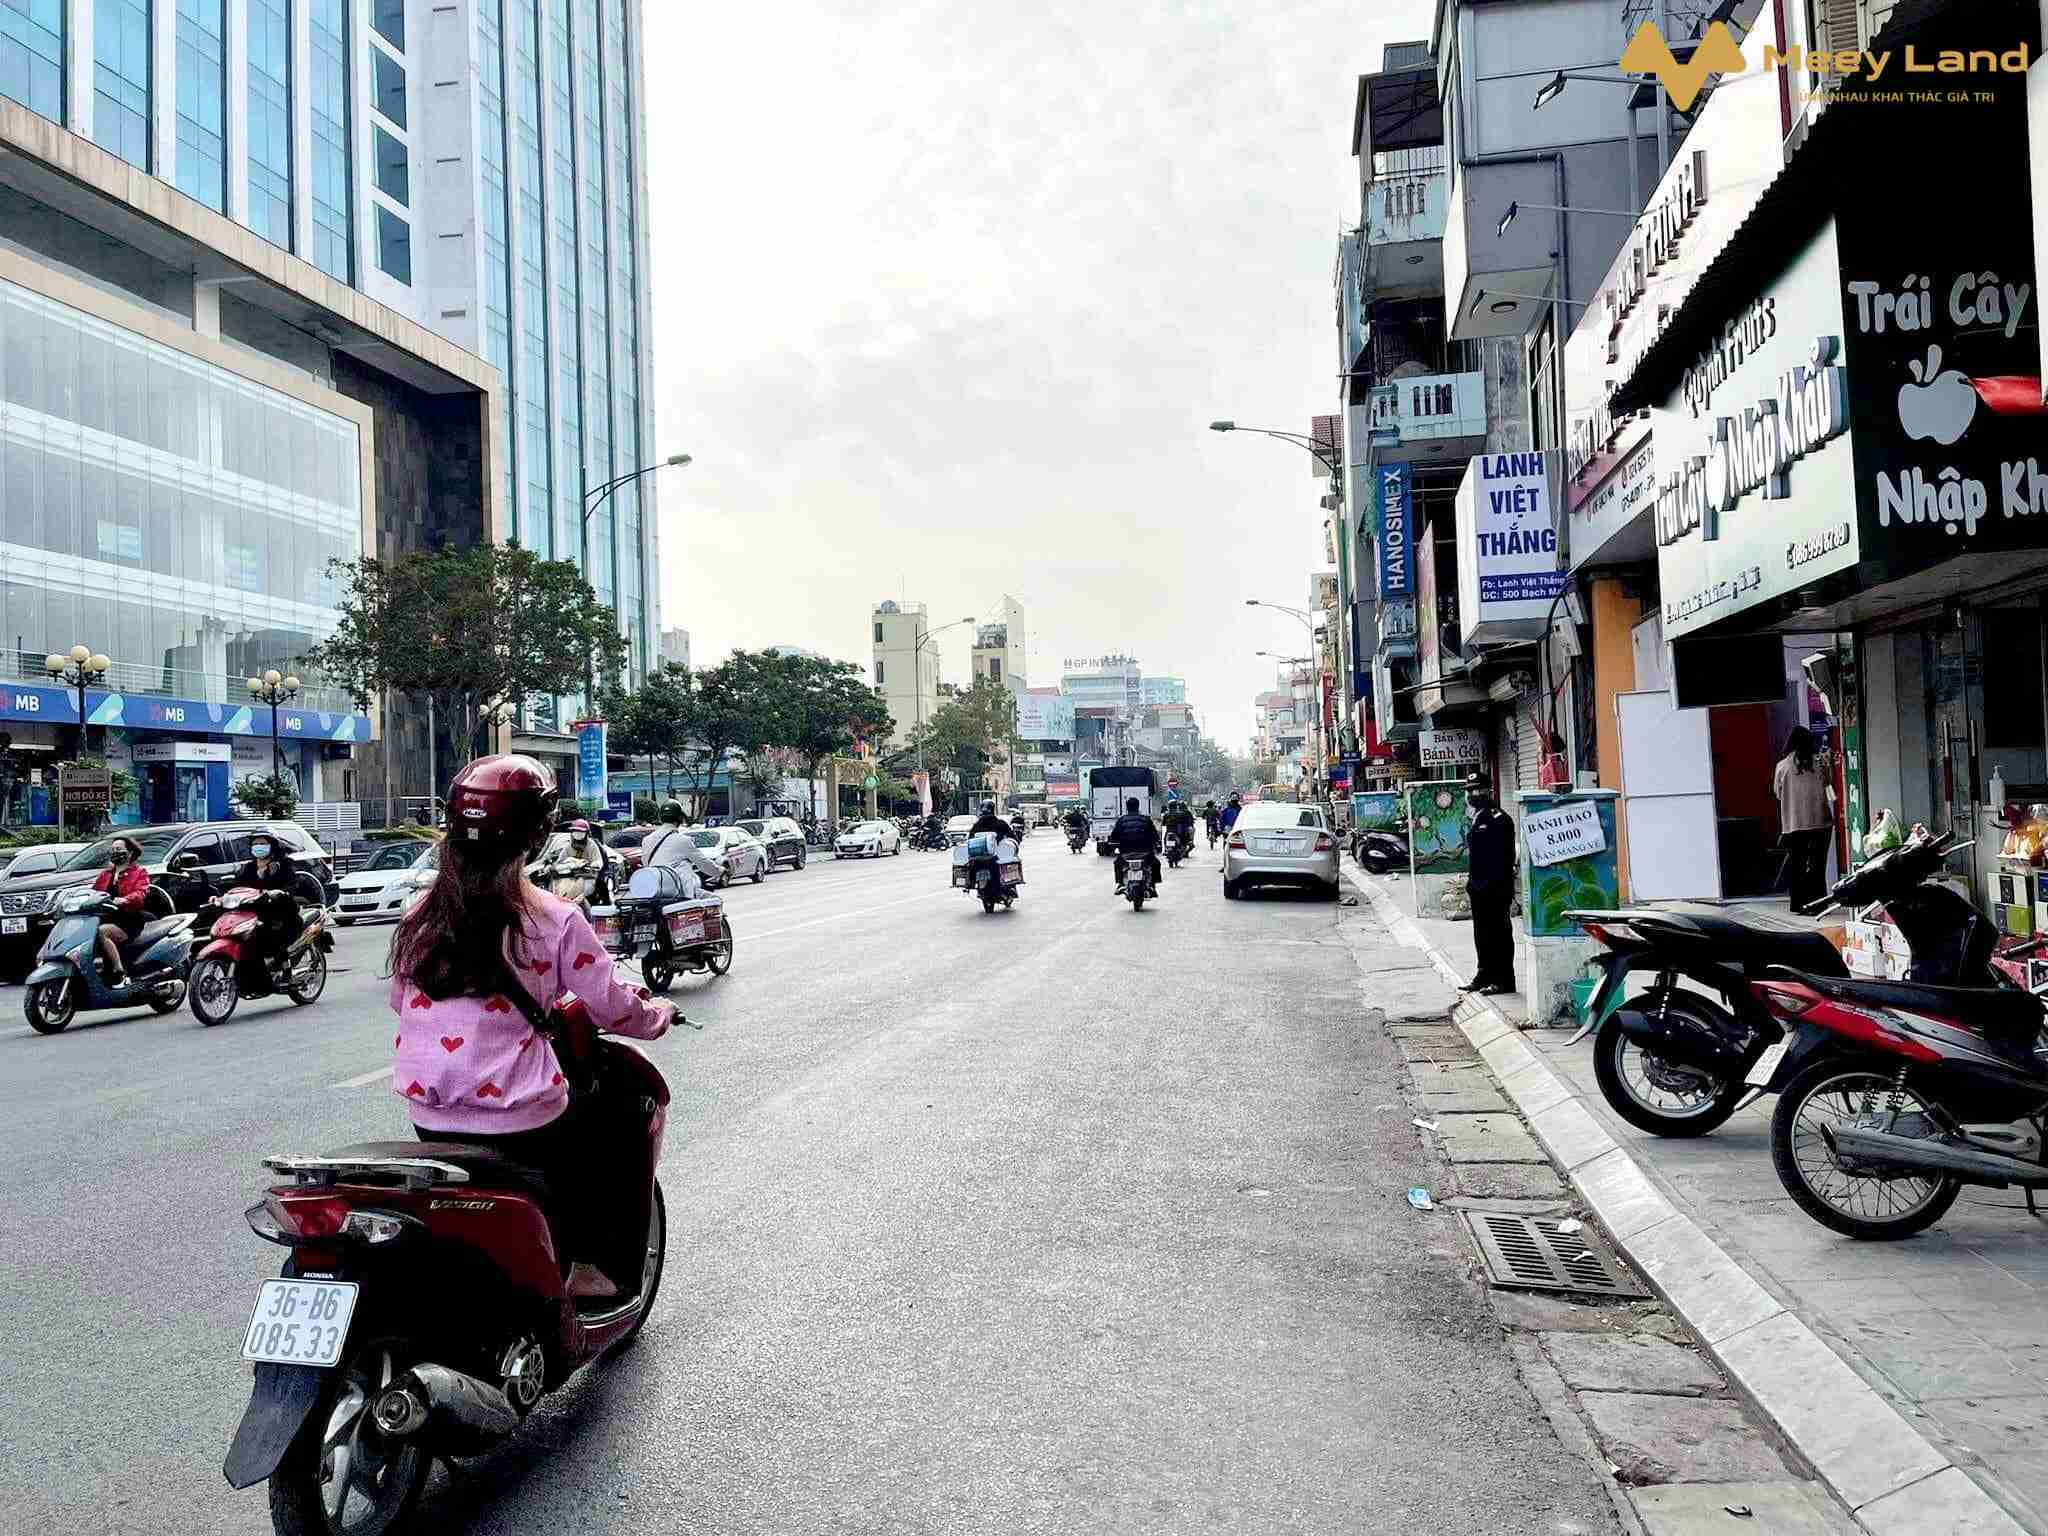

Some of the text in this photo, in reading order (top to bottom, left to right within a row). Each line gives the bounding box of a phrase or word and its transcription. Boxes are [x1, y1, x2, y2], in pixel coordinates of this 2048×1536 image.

[1847, 271, 2031, 338] Trái Cây
[1728, 400, 1785, 499] Nhập
[1482, 452, 1544, 479] LANH
[1490, 485, 1539, 517] VIỆT
[1876, 468, 1987, 536] Nhập
[1385, 468, 1405, 590] HANOSIMEX
[1477, 521, 1556, 556] THẮNG
[1498, 579, 1518, 587] Lanh
[1503, 590, 1519, 599] 500
[16, 694, 39, 712] MB
[165, 707, 185, 723] MB
[285, 717, 301, 730] MB
[96, 791, 107, 800] XE
[1566, 810, 1592, 825] BAO
[1546, 828, 1581, 845] 8.000
[267, 1285, 341, 1321] 36-B6
[248, 1322, 340, 1360] 085.33
